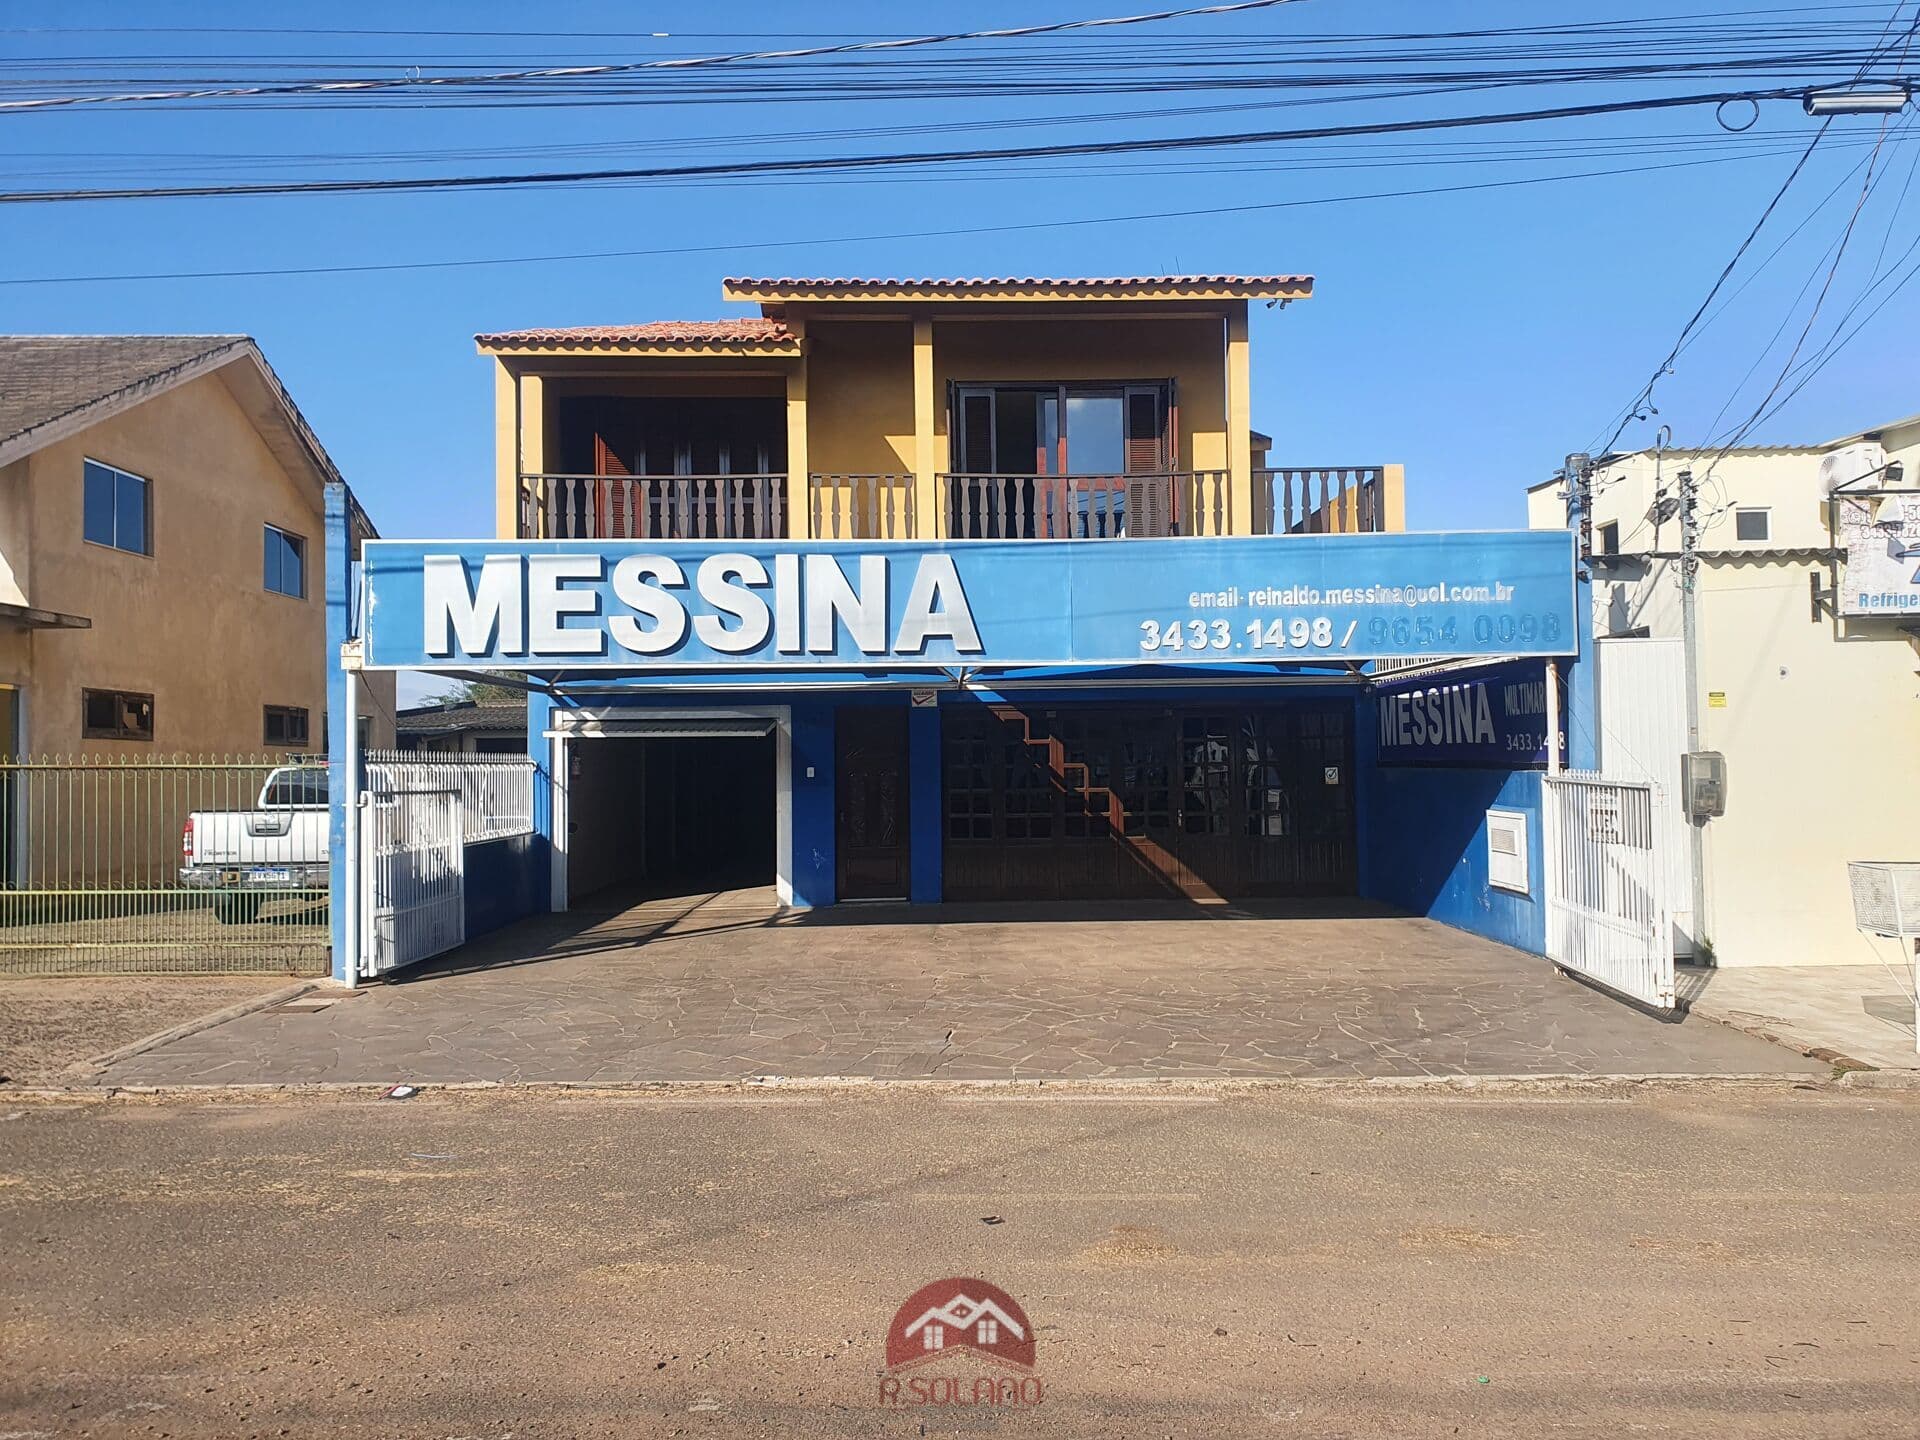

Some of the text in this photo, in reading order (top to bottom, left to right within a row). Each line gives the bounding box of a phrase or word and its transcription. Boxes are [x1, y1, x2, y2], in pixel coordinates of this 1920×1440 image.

[423, 553, 983, 656] MESSINA
[1248, 581, 1515, 608] reinaldo.messina@uol.com.br
[1139, 615, 1333, 651] 3433.1498
[1368, 615, 1459, 646] 9654
[1472, 611, 1562, 644] 0098
[1380, 682, 1497, 747] MESSINA
[1506, 730, 1566, 751] 3433.148
